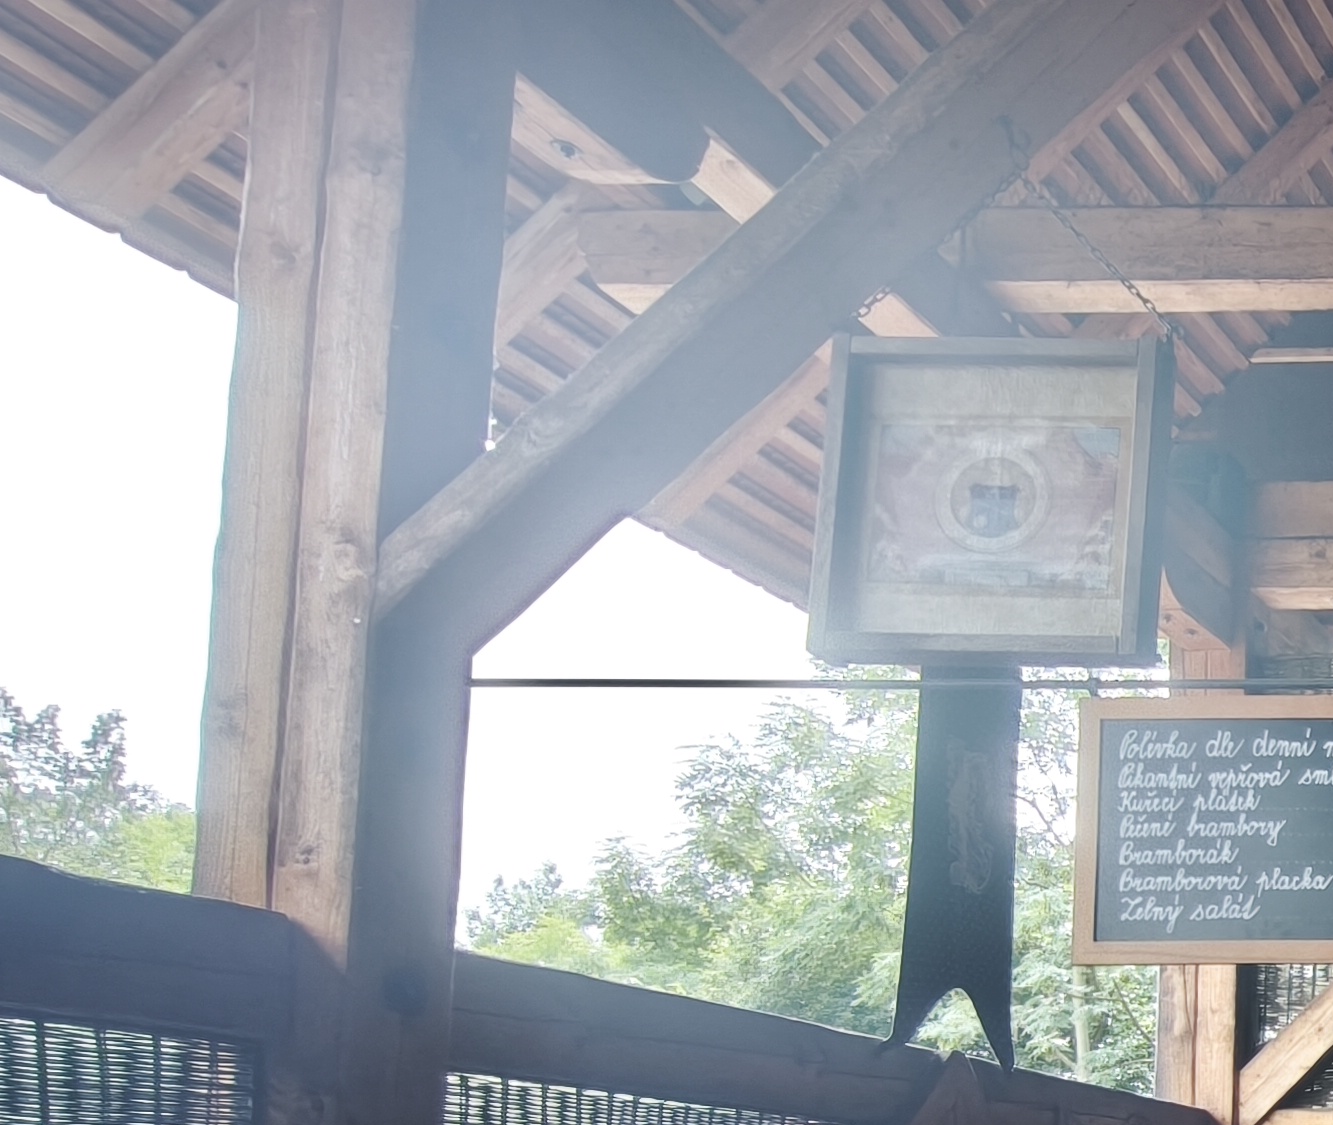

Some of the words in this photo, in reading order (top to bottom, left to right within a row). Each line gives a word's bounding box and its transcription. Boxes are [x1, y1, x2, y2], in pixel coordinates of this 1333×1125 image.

[1205, 730, 1245, 758] dle
[1252, 728, 1317, 758] denní
[1208, 760, 1290, 796] vepřová
[1187, 813, 1287, 847] brambory
[1118, 838, 1239, 865] Bramborák
[1118, 866, 1248, 892] Bramborová
[1255, 866, 1333, 898] placka
[1120, 894, 1184, 934] Zelný
